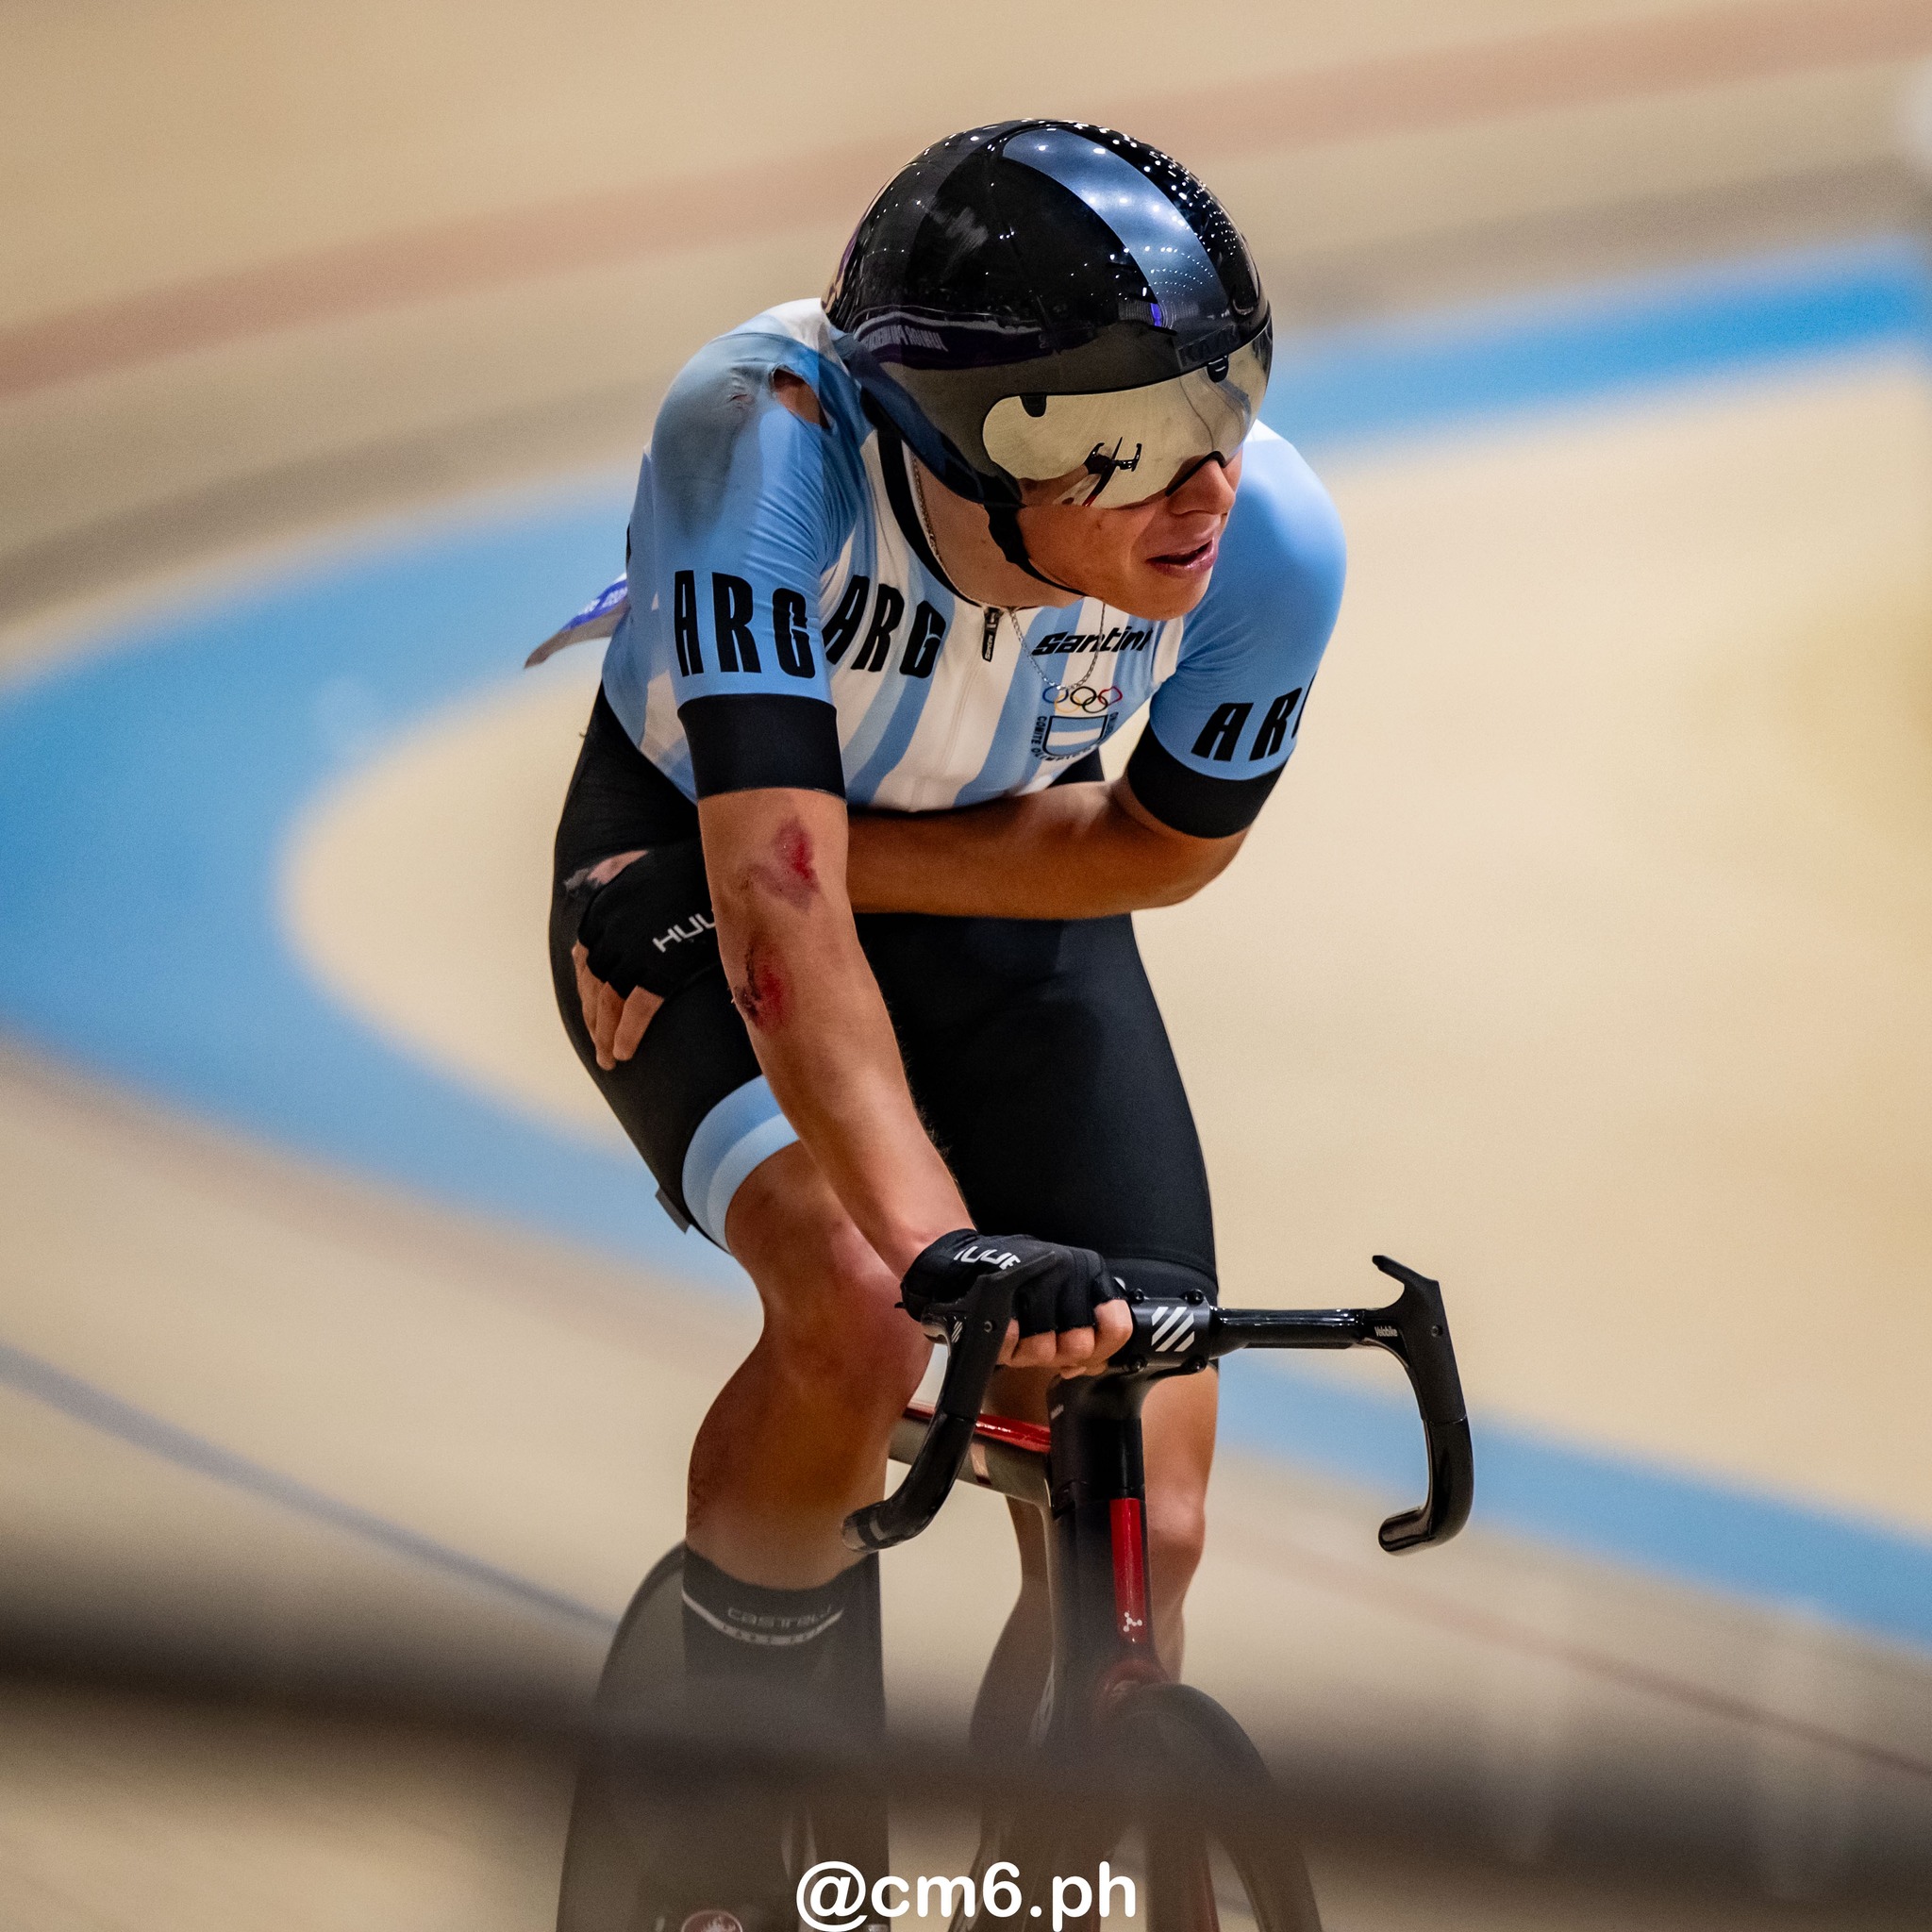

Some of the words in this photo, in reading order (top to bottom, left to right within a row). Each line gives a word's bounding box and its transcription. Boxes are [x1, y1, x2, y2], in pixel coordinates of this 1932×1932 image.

[674, 570, 816, 679] ARG
[822, 575, 947, 679] ARG
[1031, 625, 1154, 657] Santini
[1191, 669, 1317, 762] AR
